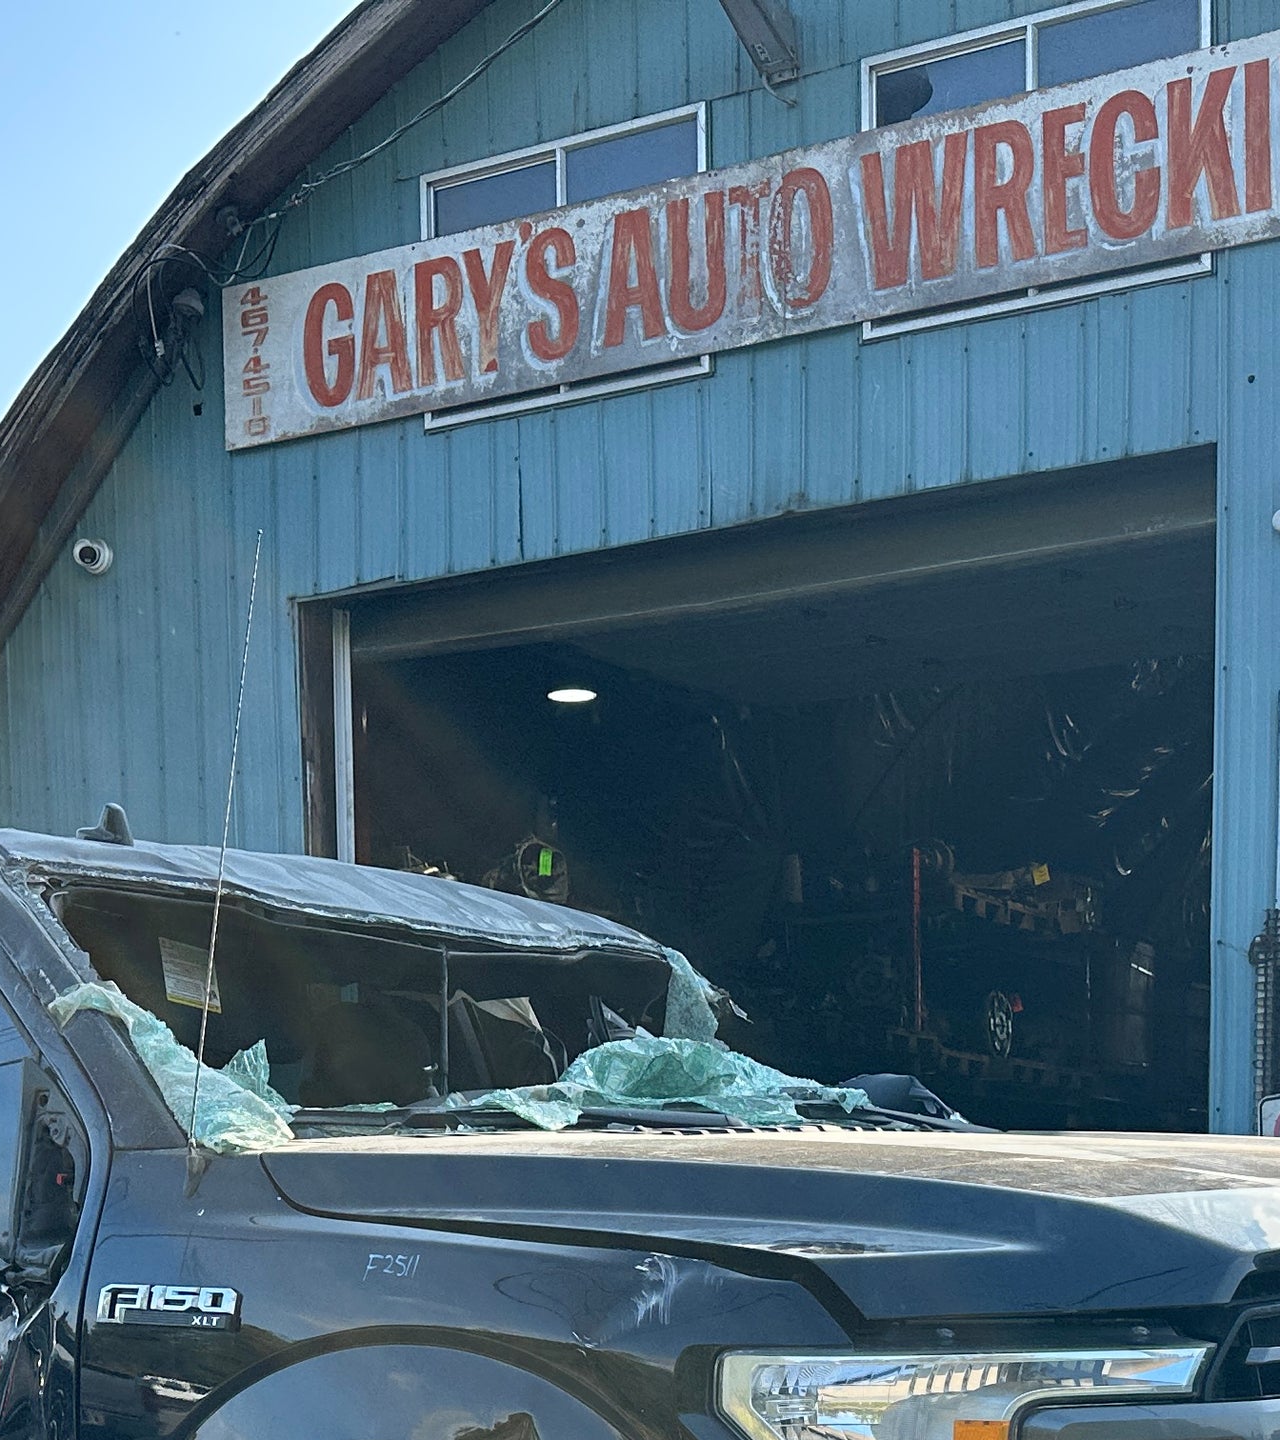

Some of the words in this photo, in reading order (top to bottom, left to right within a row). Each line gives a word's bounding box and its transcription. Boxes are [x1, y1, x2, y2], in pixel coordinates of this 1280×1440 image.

[302, 221, 580, 408] GARY'S
[604, 167, 834, 348] AUTO
[361, 1253, 421, 1282] F2511
[191, 1315, 221, 1328] XLT
